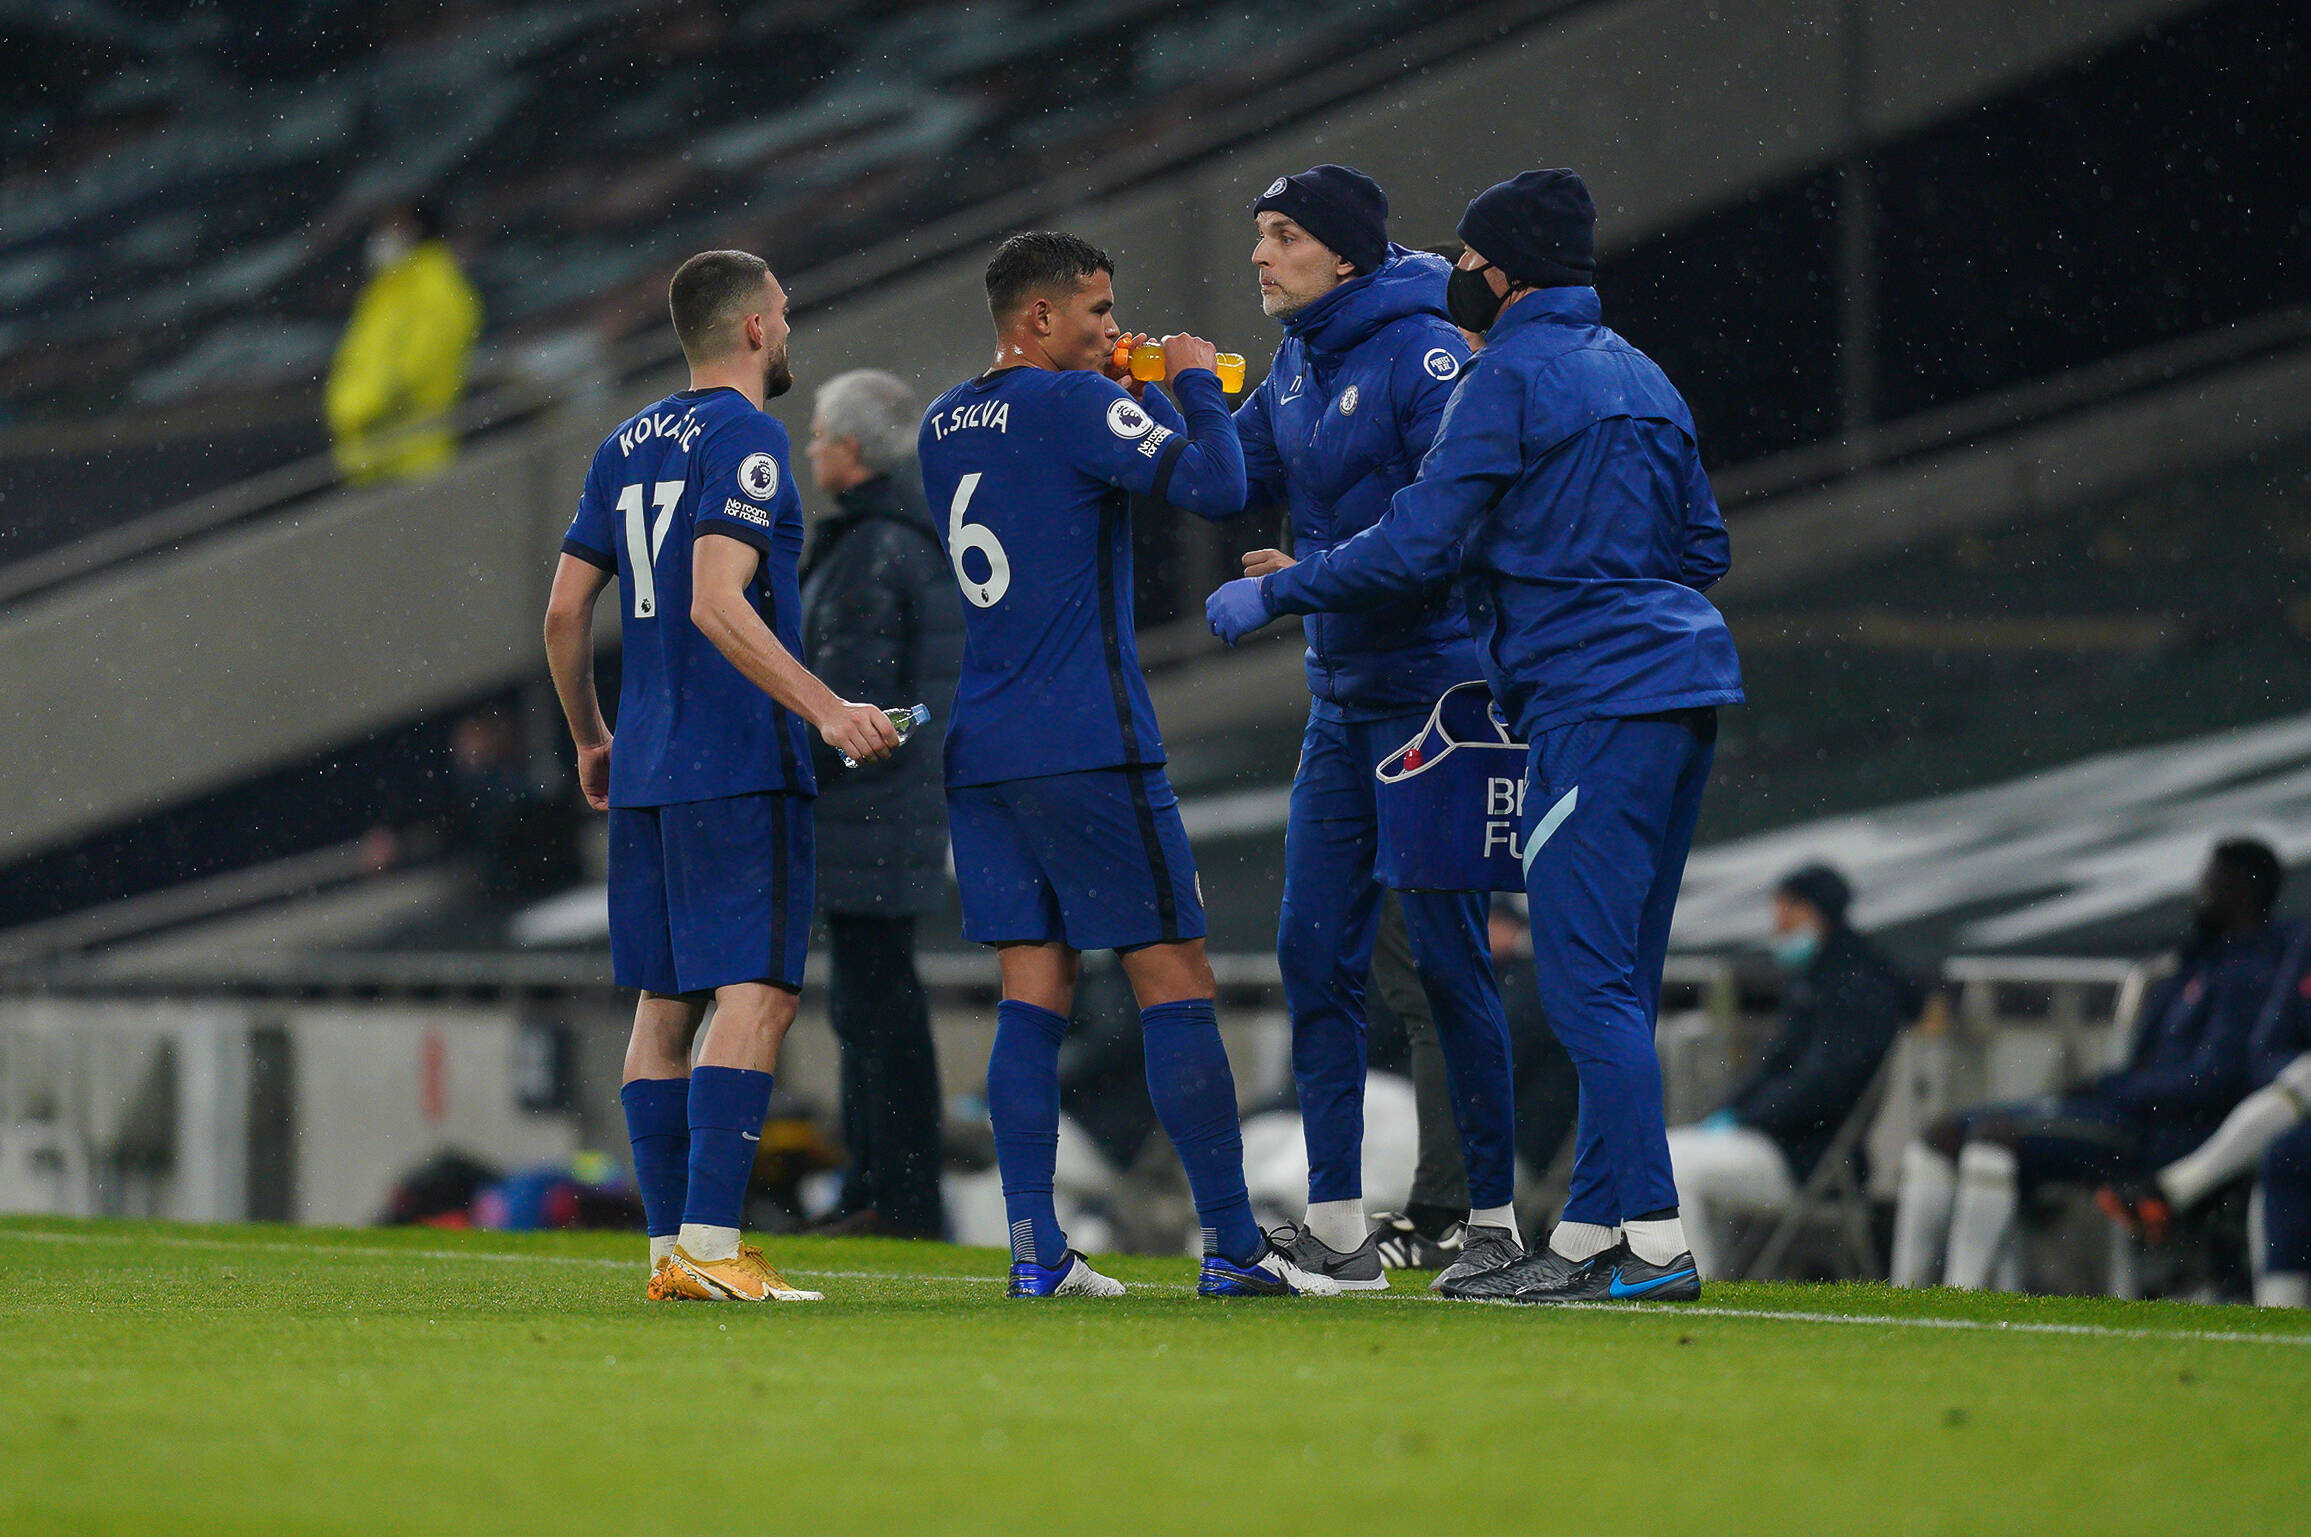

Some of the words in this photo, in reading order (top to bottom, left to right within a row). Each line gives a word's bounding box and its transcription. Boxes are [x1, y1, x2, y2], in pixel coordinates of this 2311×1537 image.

[724, 506, 739, 517] for
[739, 511, 770, 527] racism
[726, 497, 741, 508] No
[742, 503, 767, 519] room
[615, 480, 685, 618] 17
[948, 472, 1010, 608] 6
[1484, 821, 1523, 859] Fu
